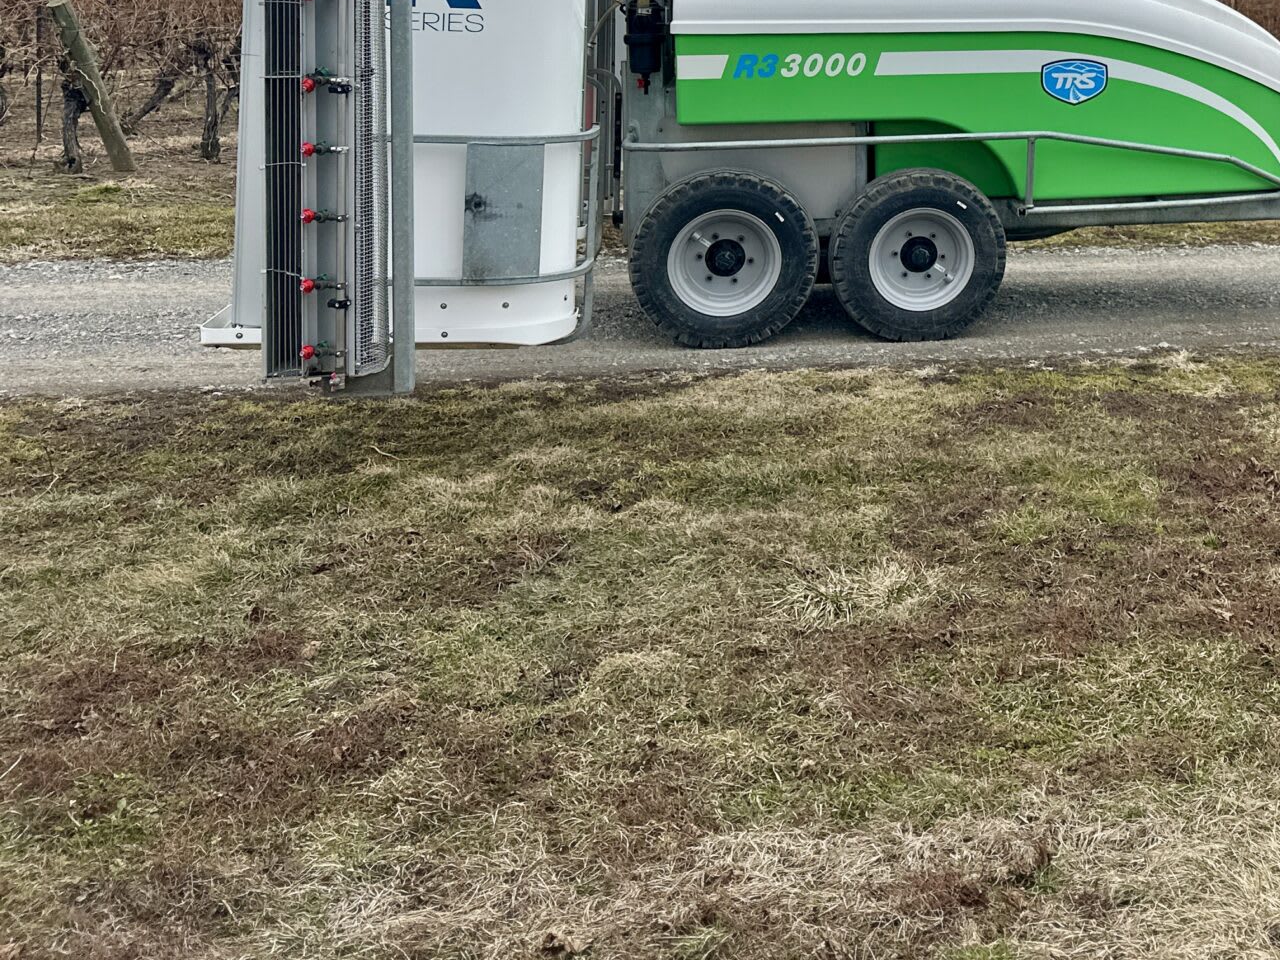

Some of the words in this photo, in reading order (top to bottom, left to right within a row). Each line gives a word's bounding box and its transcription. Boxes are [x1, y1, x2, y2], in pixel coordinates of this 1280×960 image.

[733, 53, 779, 79] R3
[780, 52, 867, 78] 3000
[1051, 72, 1097, 90] TRS
